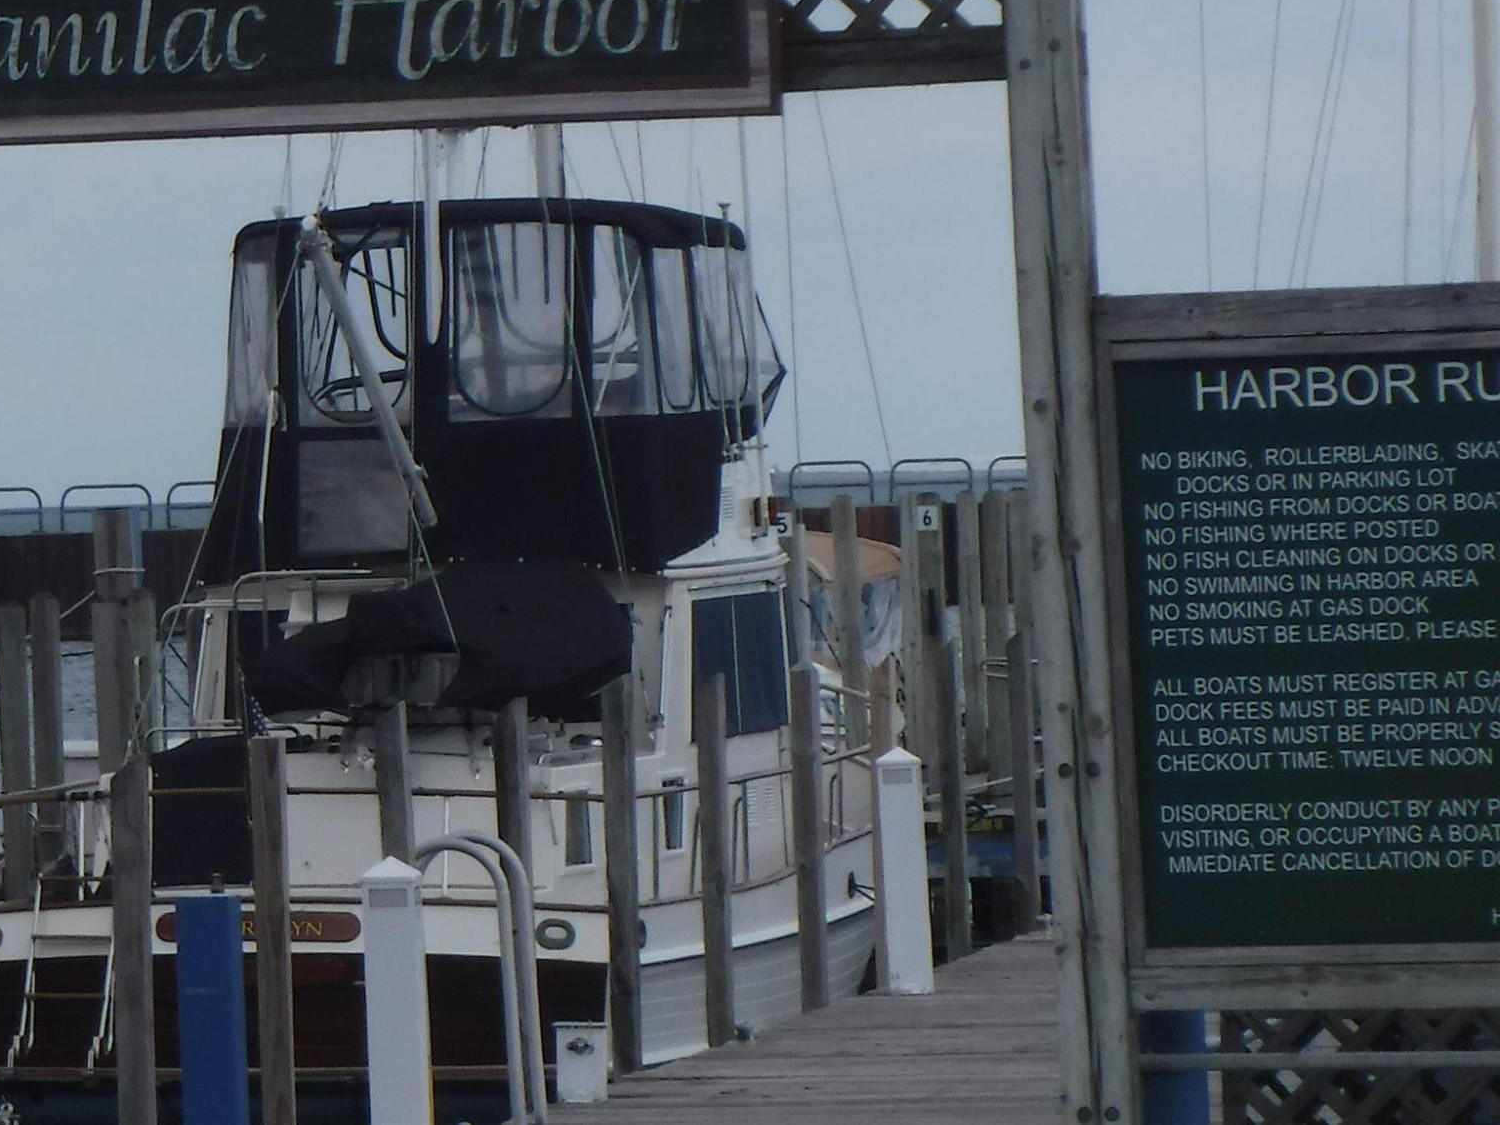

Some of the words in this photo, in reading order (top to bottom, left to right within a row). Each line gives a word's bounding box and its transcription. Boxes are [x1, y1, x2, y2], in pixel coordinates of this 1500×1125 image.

[1195, 364, 1420, 411] HARBOR
[1141, 452, 1172, 471] NO
[1456, 440, 1500, 462] SKA
[1177, 475, 1249, 495] DOCKS
[1256, 474, 1286, 492] OR
[1293, 473, 1313, 491] IN
[1319, 469, 1410, 490] PARKING
[1417, 467, 1457, 487] LOT
[922, 509, 932, 526] 6
[1144, 502, 1175, 521] NO
[1181, 499, 1264, 520] FISHING
[1269, 497, 1331, 517] FROM
[1337, 495, 1410, 515] DOCKS
[1416, 493, 1447, 512] OR
[1453, 492, 1500, 512] BOA
[777, 516, 788, 534] 5
[1146, 527, 1176, 546] NO
[1182, 524, 1265, 545] FISHING
[1271, 522, 1347, 542] WHERE
[1354, 519, 1440, 539] POSTED
[1147, 553, 1177, 571] NO
[1183, 550, 1229, 569] FISH
[1235, 547, 1342, 568] CLEANING
[1348, 546, 1378, 565] ON
[1385, 544, 1458, 563] DOCKS
[1465, 543, 1495, 562] OR
[1148, 578, 1179, 596] NO
[1185, 574, 1294, 596] SWIMMING
[1301, 574, 1321, 592] IN
[1327, 571, 1415, 590] HARBOR
[1422, 569, 1479, 588] AREA
[1150, 603, 1180, 622] NO
[1186, 599, 1283, 621] SMOKING
[1289, 598, 1313, 617] AT
[1320, 597, 1363, 616] GAS
[1369, 596, 1430, 615] DOCK
[1151, 627, 1204, 647] PETS
[1210, 626, 1269, 645] MUST
[1275, 624, 1302, 643] BE
[1417, 619, 1498, 640] PLEASE
[1154, 678, 1188, 697] ALL
[1194, 676, 1262, 696] BOATS
[1268, 674, 1327, 694] MUST
[1334, 671, 1437, 692] REGISTER
[1444, 670, 1468, 689] AT
[1155, 703, 1214, 722] DOCK
[1220, 701, 1273, 720] FEES
[1279, 699, 1338, 719] MUST
[1344, 698, 1371, 717] BE
[1378, 697, 1424, 717] PAID
[1430, 696, 1450, 715] IN
[1456, 695, 1500, 714] ADV
[1157, 728, 1192, 747] ALL
[1199, 726, 1267, 746] BOATS
[1273, 724, 1331, 745] MUST
[1338, 723, 1364, 743] BE
[1372, 721, 1482, 742] PROPERLY
[1158, 751, 1273, 772] CHECKOUT
[1279, 750, 1334, 770] TIME:
[1340, 748, 1424, 768] TWELVE
[1430, 747, 1493, 766] NOON
[1161, 802, 1292, 823] DISORDERLY
[1299, 799, 1401, 820] CONDUCT
[1408, 799, 1432, 818] BY
[1439, 799, 1481, 818] ANY
[1260, 827, 1290, 846] OR
[1297, 824, 1422, 846] OCCUPYING
[1428, 825, 1443, 843] A
[1282, 850, 1439, 872] CANCELLATION
[1447, 850, 1474, 869] OF
